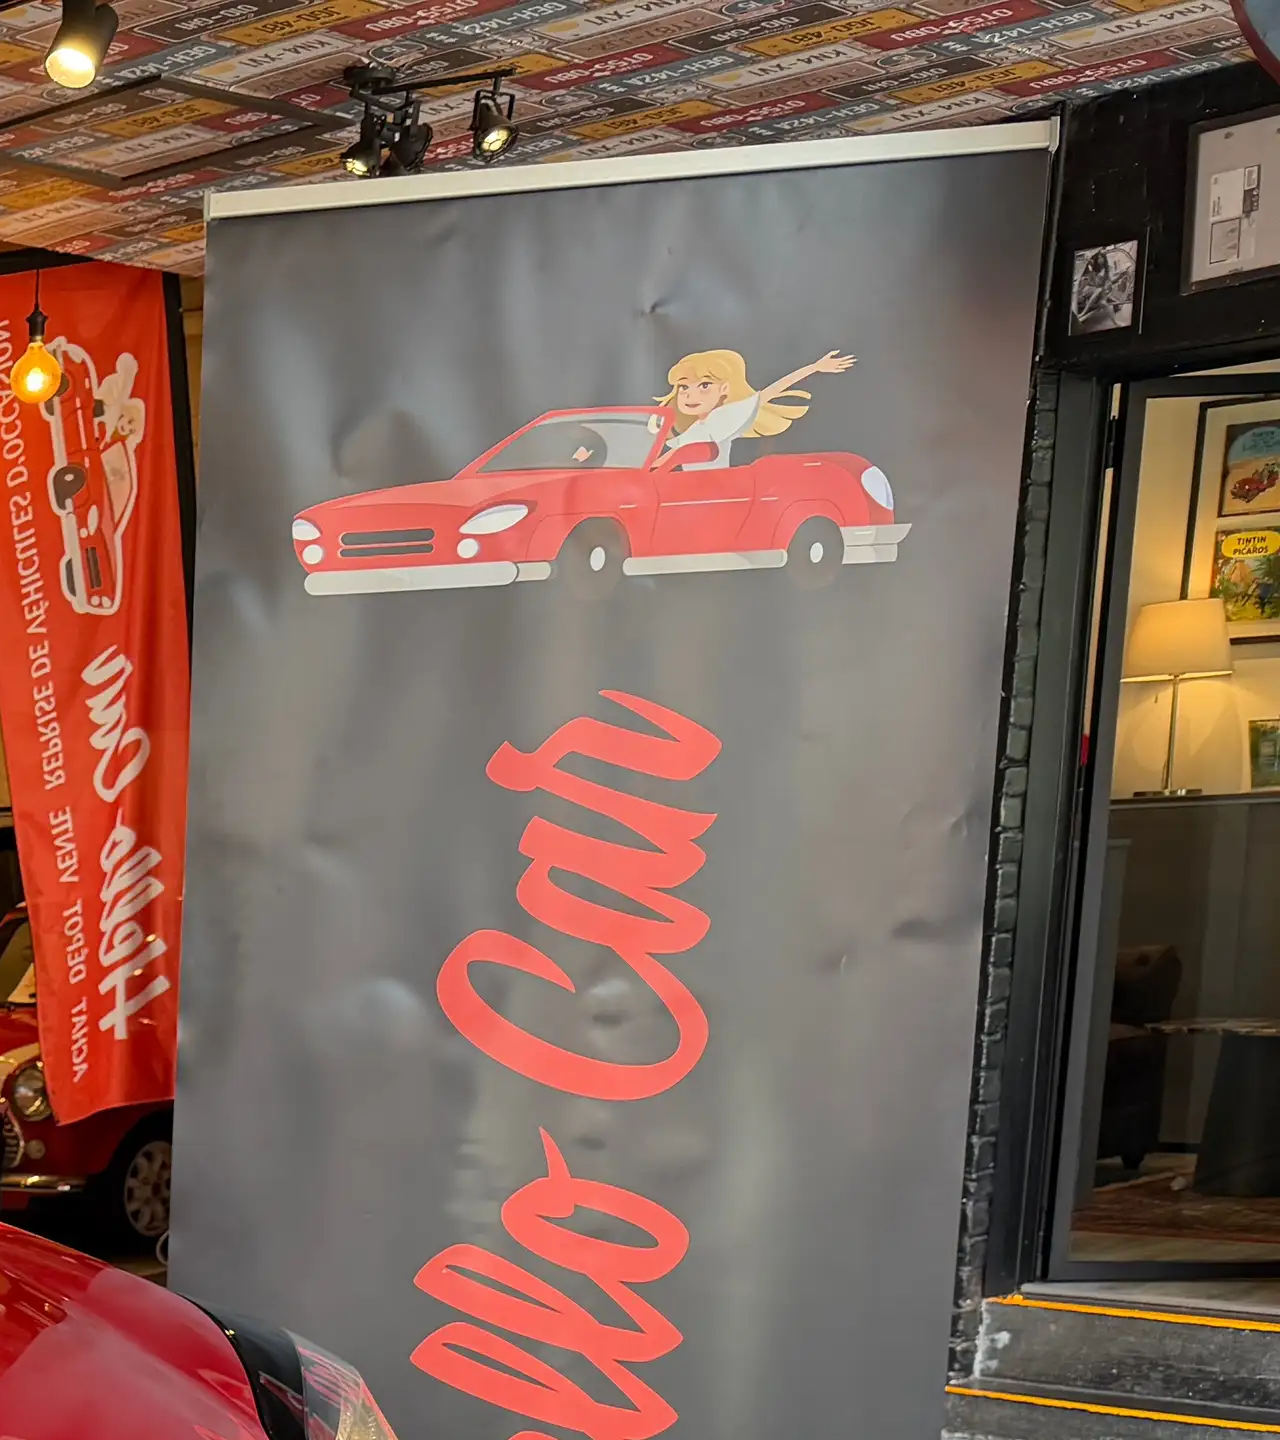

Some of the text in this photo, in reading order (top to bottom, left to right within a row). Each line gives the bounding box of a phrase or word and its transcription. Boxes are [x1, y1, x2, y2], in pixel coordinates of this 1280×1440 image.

[1236, 535, 1267, 546] TINTIN
[1232, 545, 1269, 556] PICAROS
[436, 689, 724, 1101] Car
